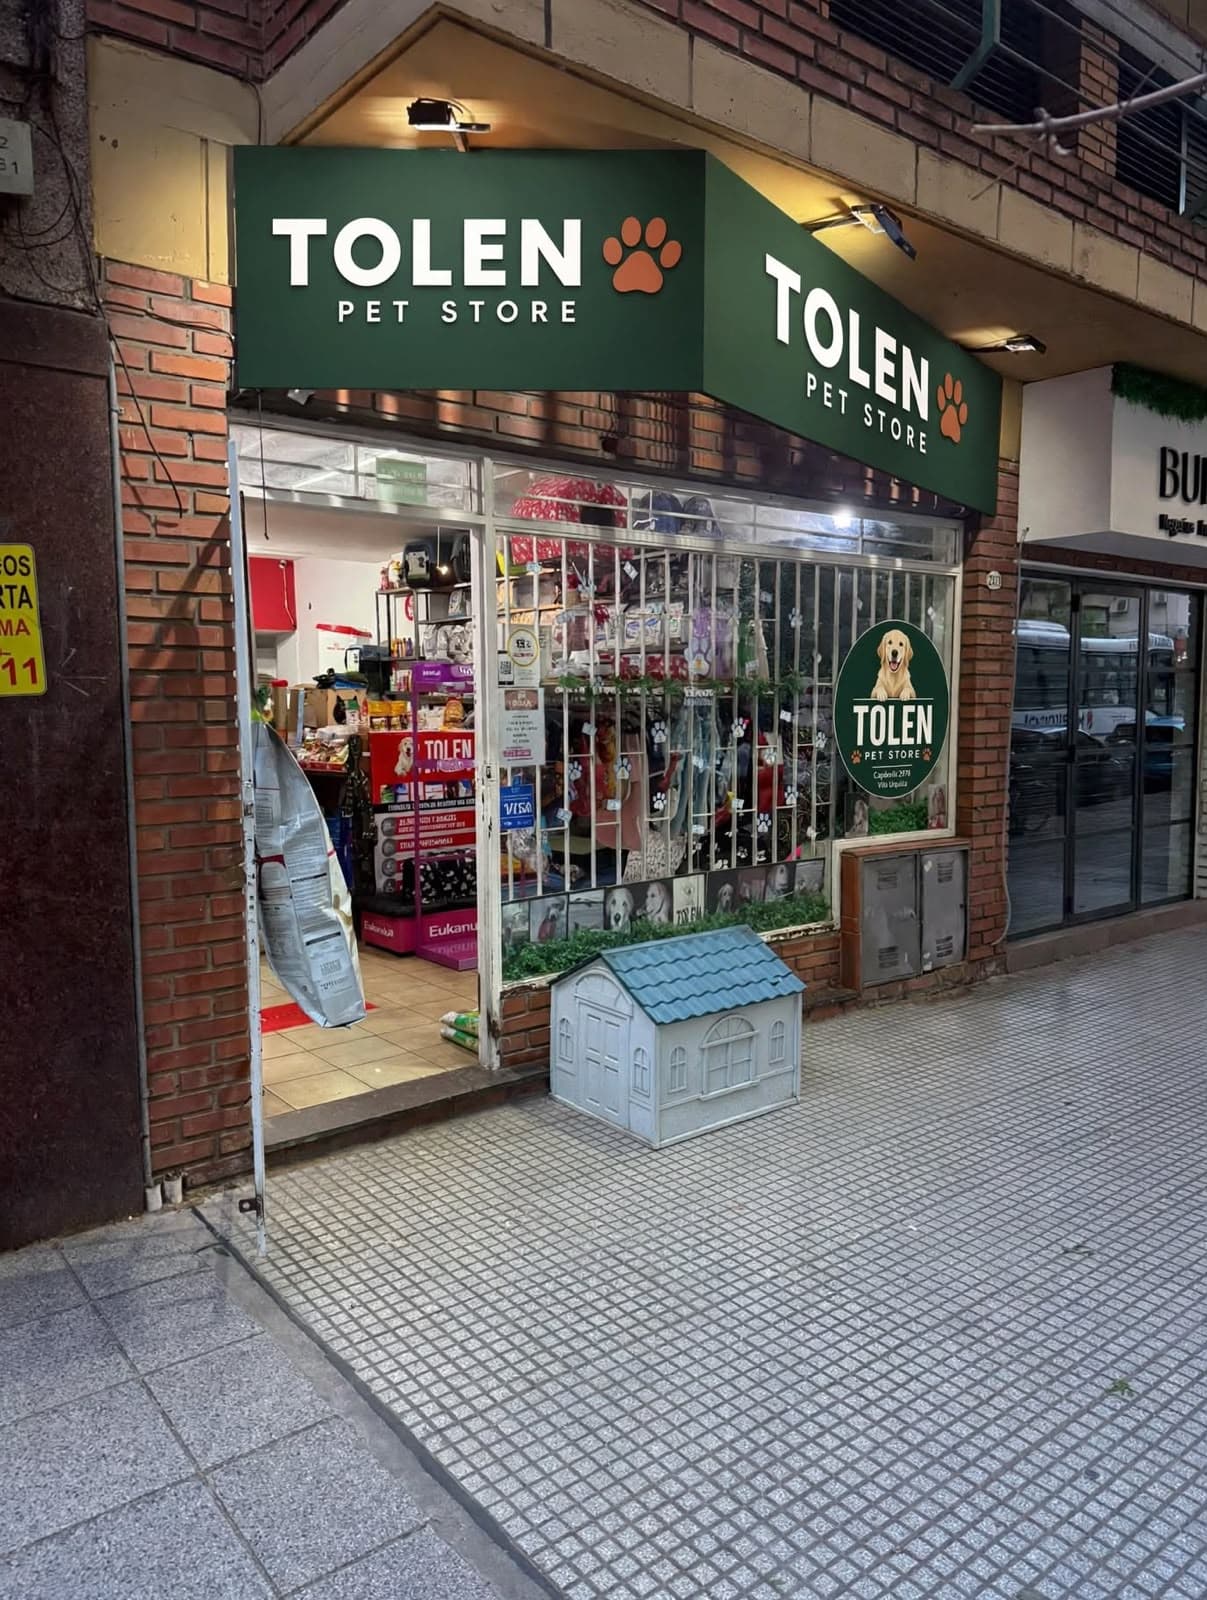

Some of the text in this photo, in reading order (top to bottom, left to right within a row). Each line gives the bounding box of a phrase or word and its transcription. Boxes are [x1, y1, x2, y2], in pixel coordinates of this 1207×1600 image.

[272, 217, 582, 288] TOLEN
[338, 300, 577, 323] PET STORE
[765, 252, 929, 422] TOLEN
[806, 372, 927, 454] PET STORE
[0, 555, 31, 577] OS
[852, 704, 933, 746] TOLEN
[424, 738, 472, 760] TOLEN
[864, 749, 921, 761] PET STORE
[503, 801, 533, 816] VISA
